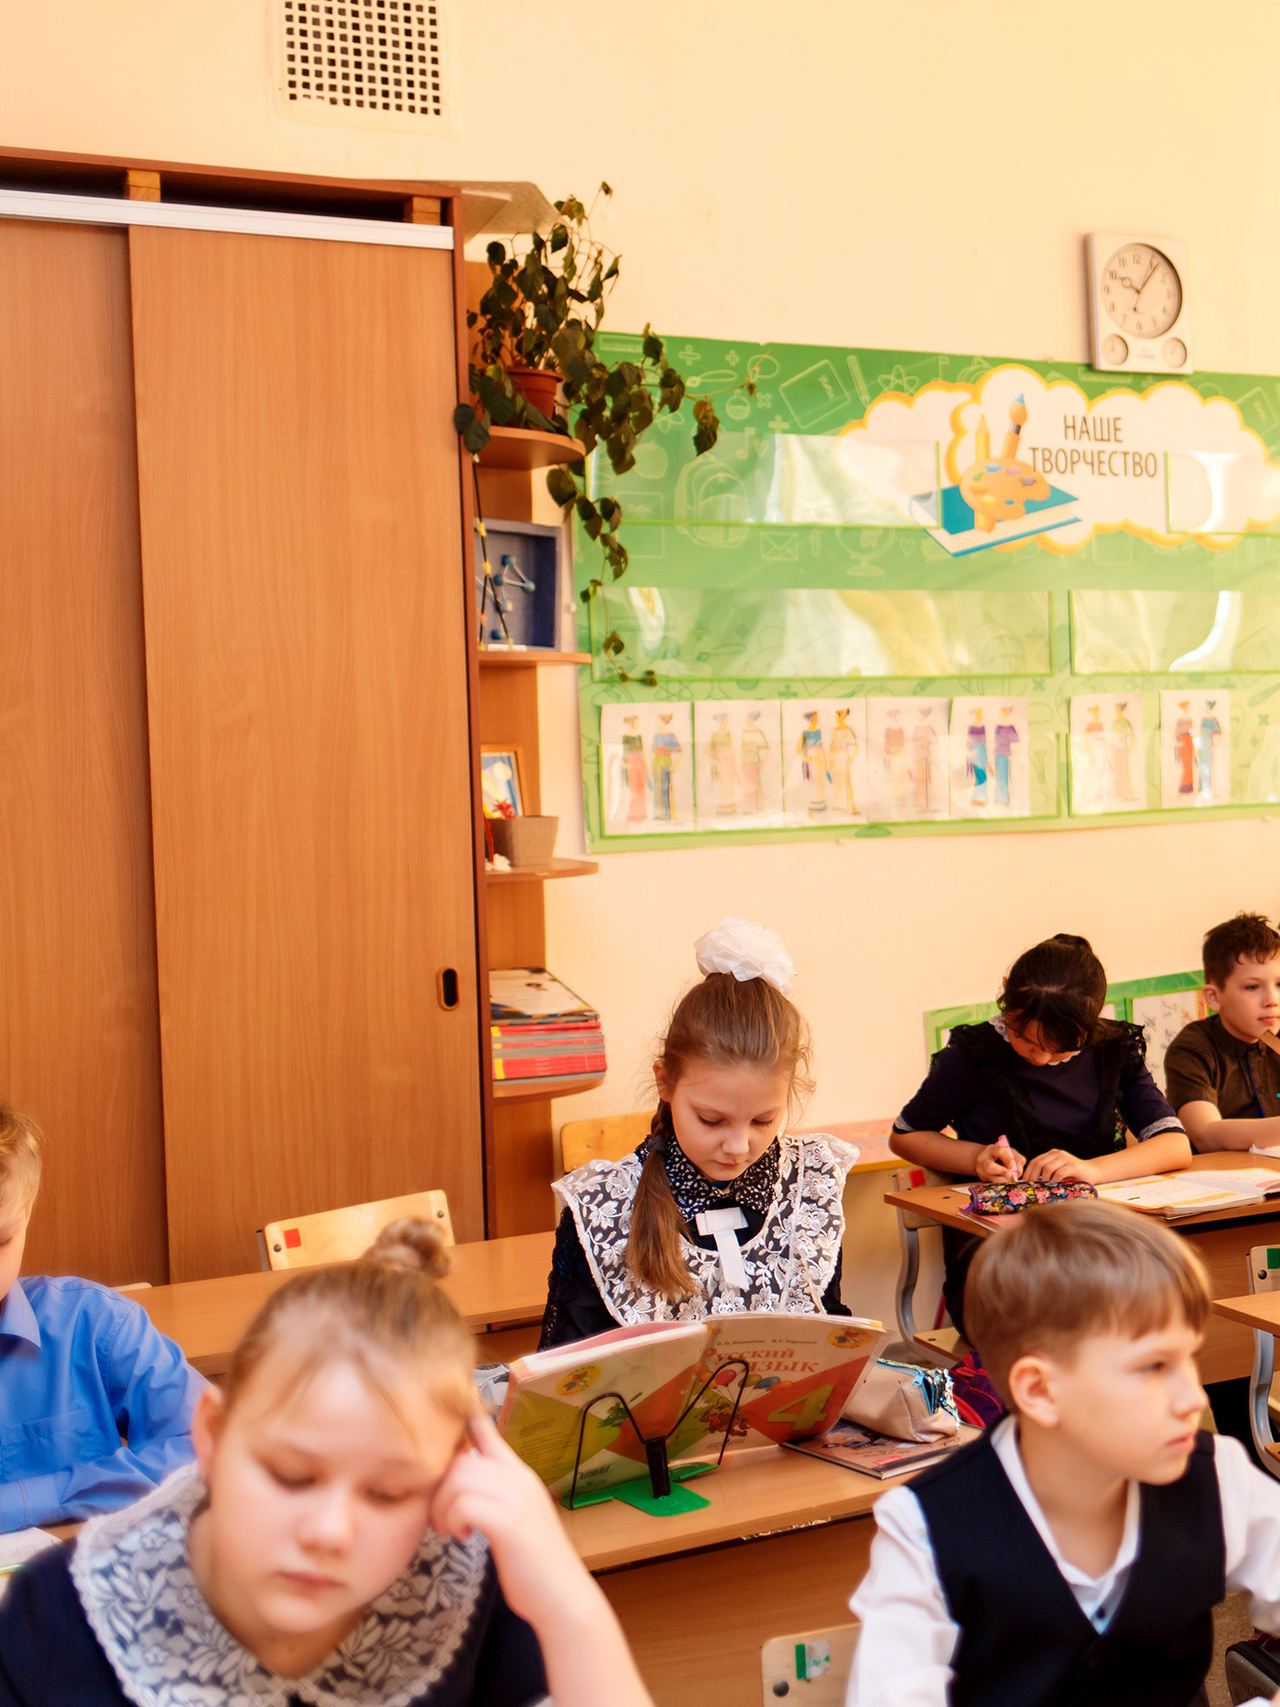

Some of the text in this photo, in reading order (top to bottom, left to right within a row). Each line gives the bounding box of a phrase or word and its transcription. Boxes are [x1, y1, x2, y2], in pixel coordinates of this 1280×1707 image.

[1118, 258, 1126, 268] 11
[1132, 254, 1141, 264] 12
[1108, 270, 1117, 280] 10
[1104, 285, 1110, 294] 9
[1109, 301, 1115, 312] 8
[1121, 313, 1127, 324] 7
[1136, 320, 1142, 330] 6
[1063, 414, 1123, 443] НАШЕ
[1028, 447, 1157, 478] ТВОРЧЕСТВО
[766, 1384, 835, 1431] 4
